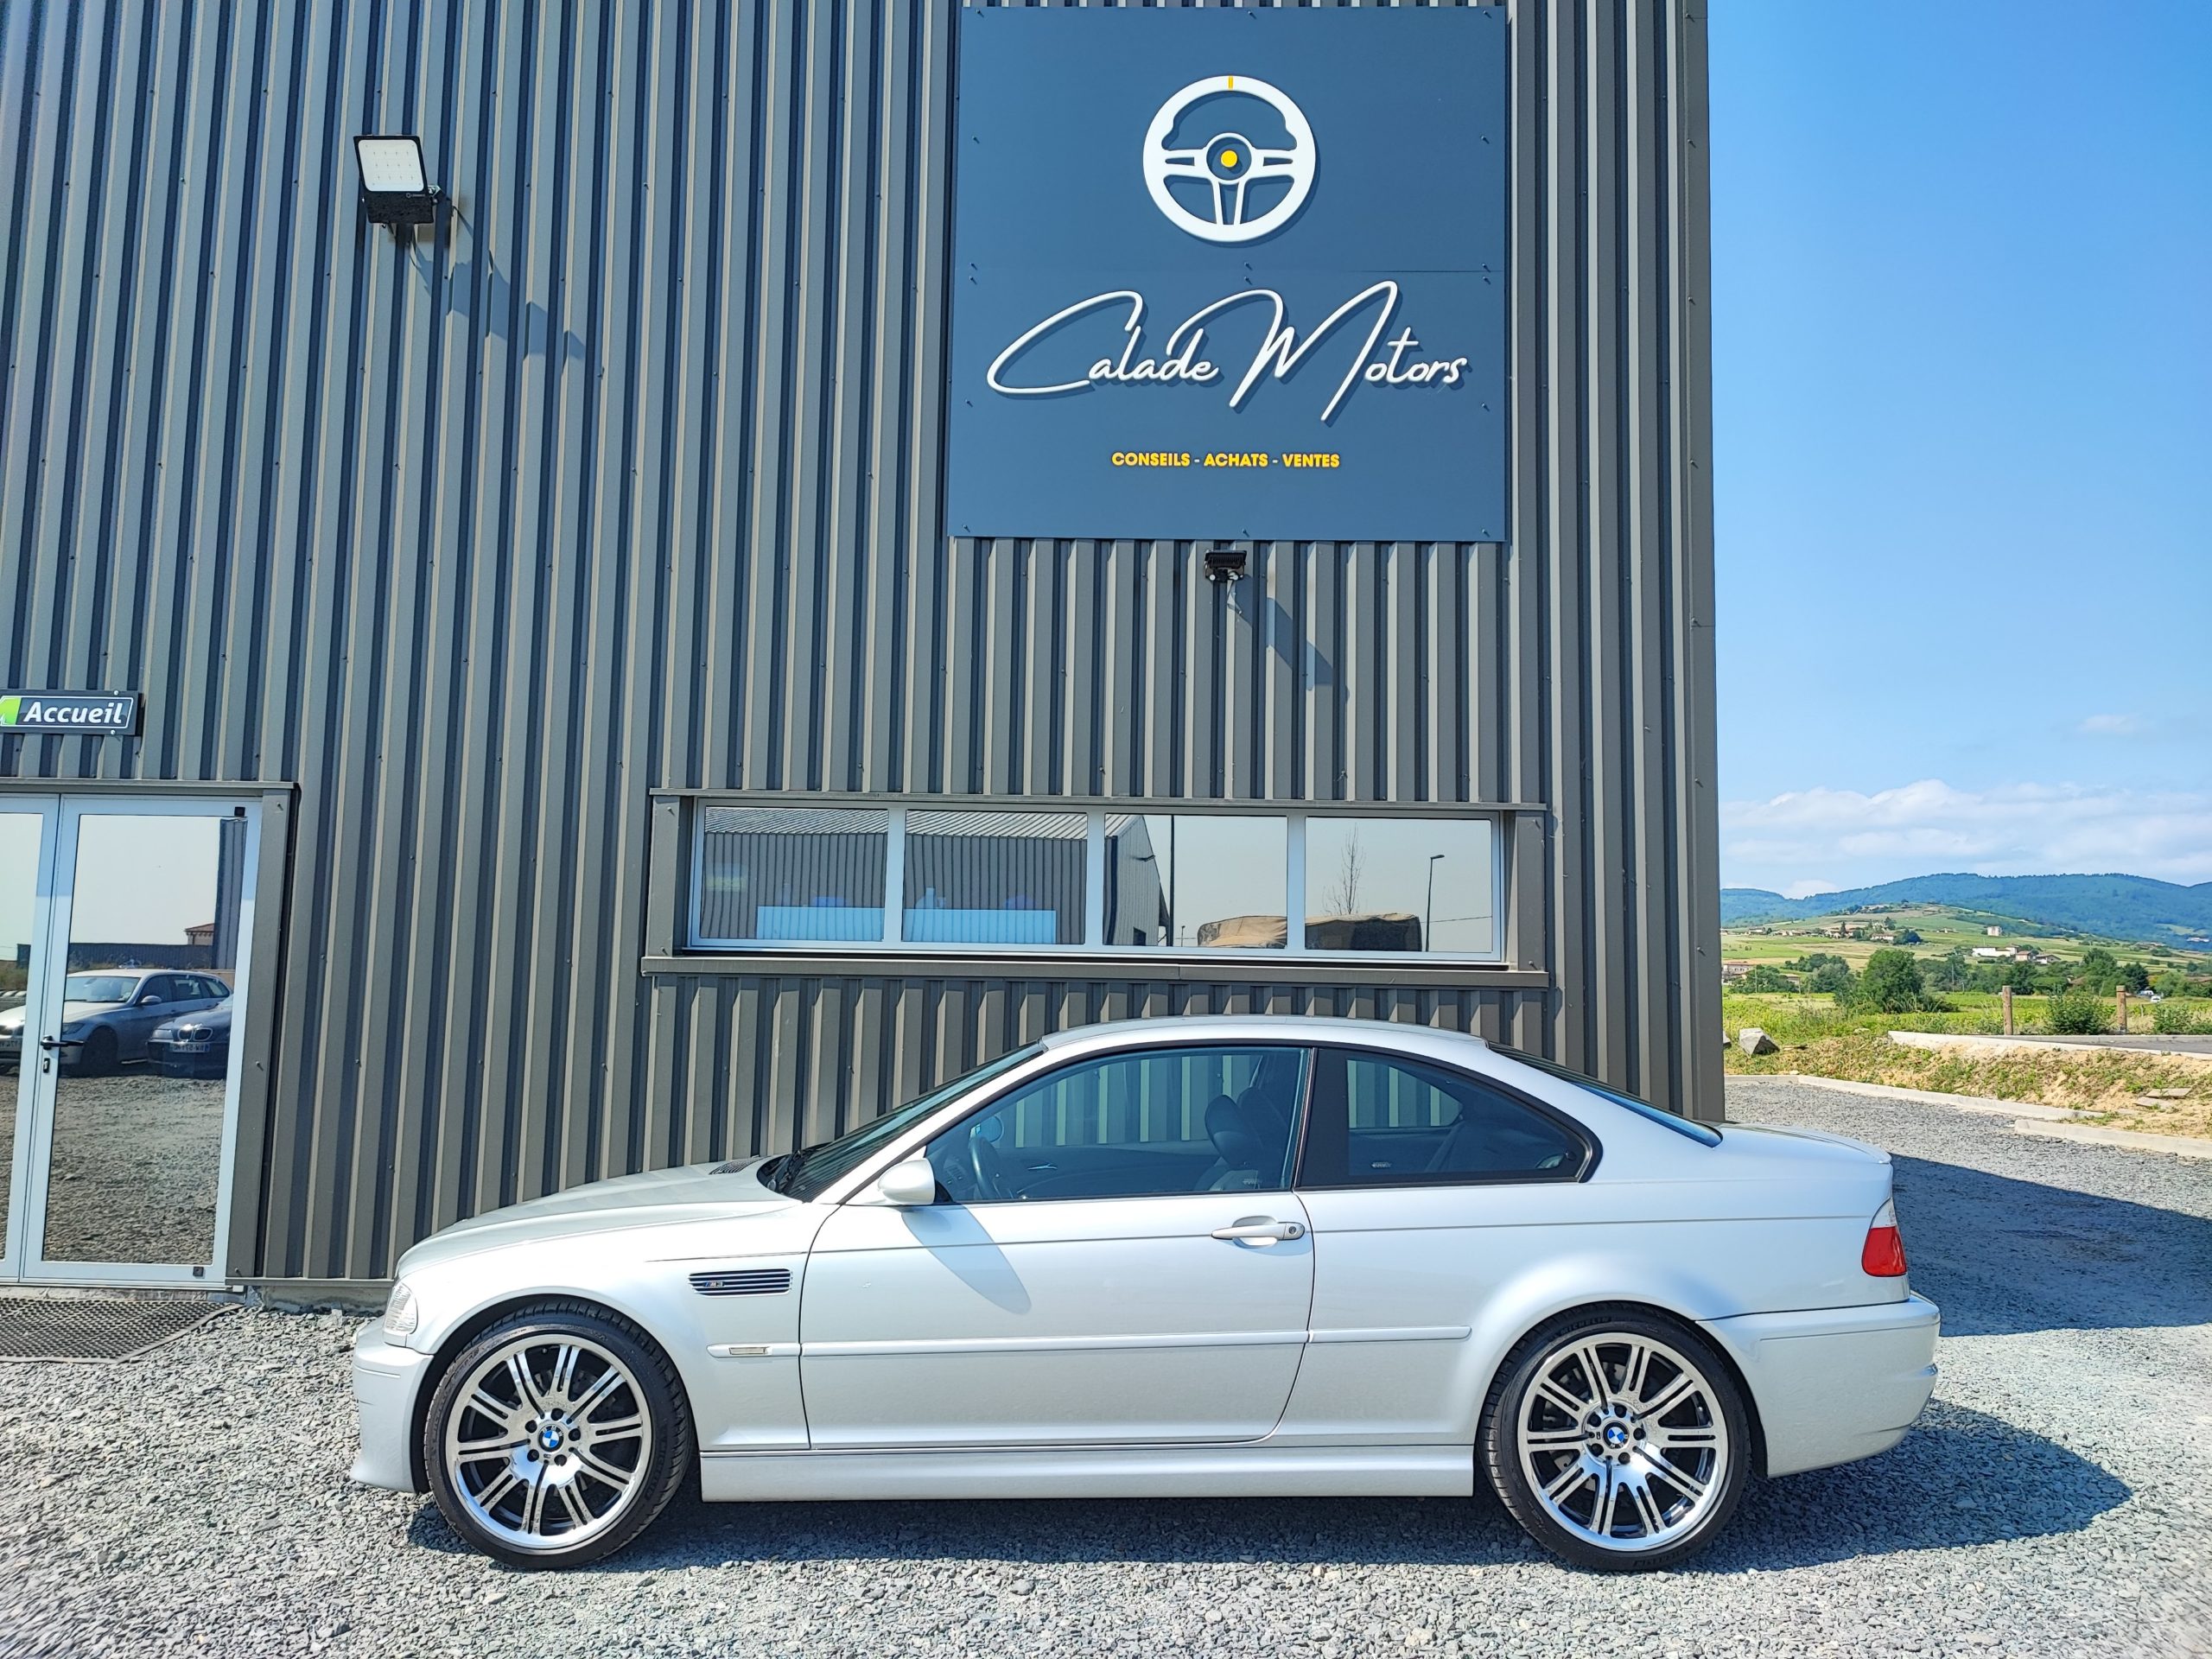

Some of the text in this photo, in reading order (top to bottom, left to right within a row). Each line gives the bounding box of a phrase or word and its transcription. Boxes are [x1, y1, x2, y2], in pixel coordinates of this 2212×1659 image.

[987, 281, 1468, 421] Calade Motors
[1111, 452, 1191, 467] CONSEILS
[1203, 453, 1268, 467] ACHATS
[1281, 454, 1340, 468] VENTES
[23, 701, 123, 724] Accueil
